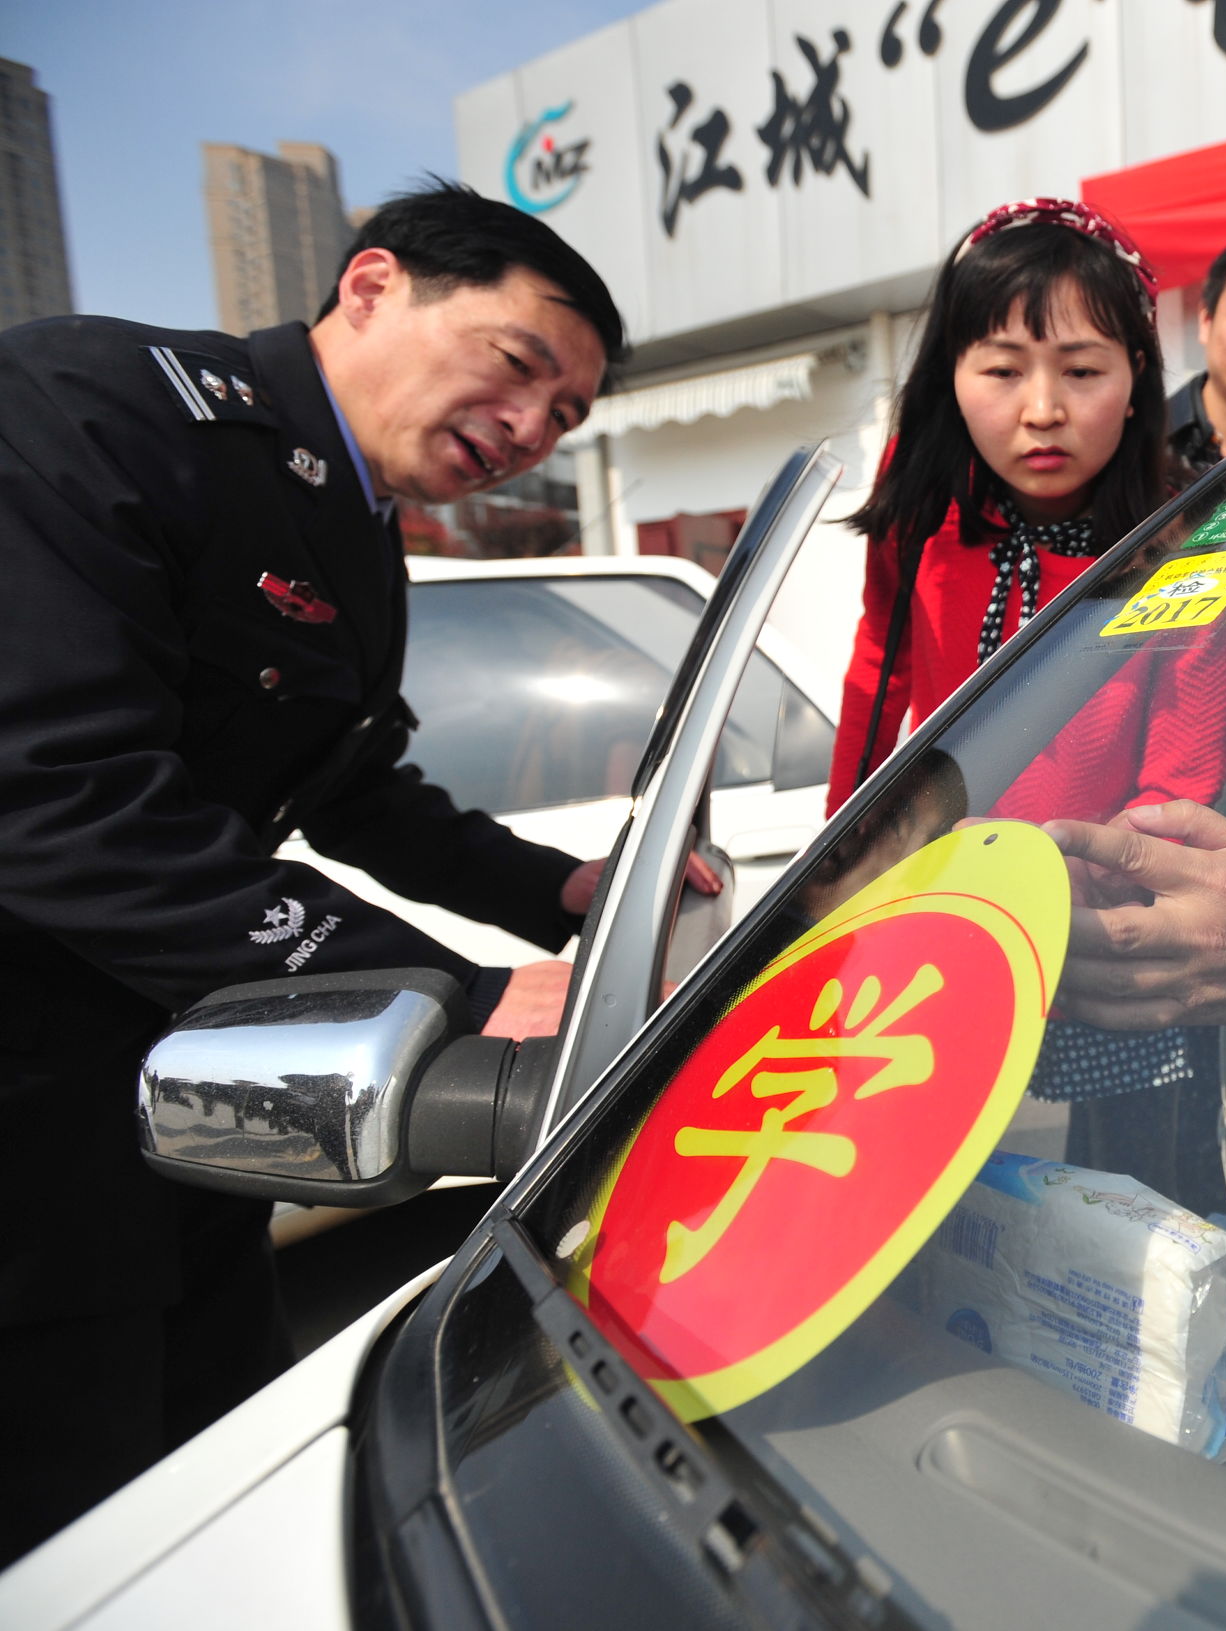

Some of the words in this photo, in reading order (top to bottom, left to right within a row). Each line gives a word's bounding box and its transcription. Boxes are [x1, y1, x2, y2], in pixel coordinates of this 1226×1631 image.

[1114, 596, 1222, 629] 2017
[284, 939, 318, 972] JING
[310, 914, 342, 943] CHA
[659, 963, 944, 1285] 学
